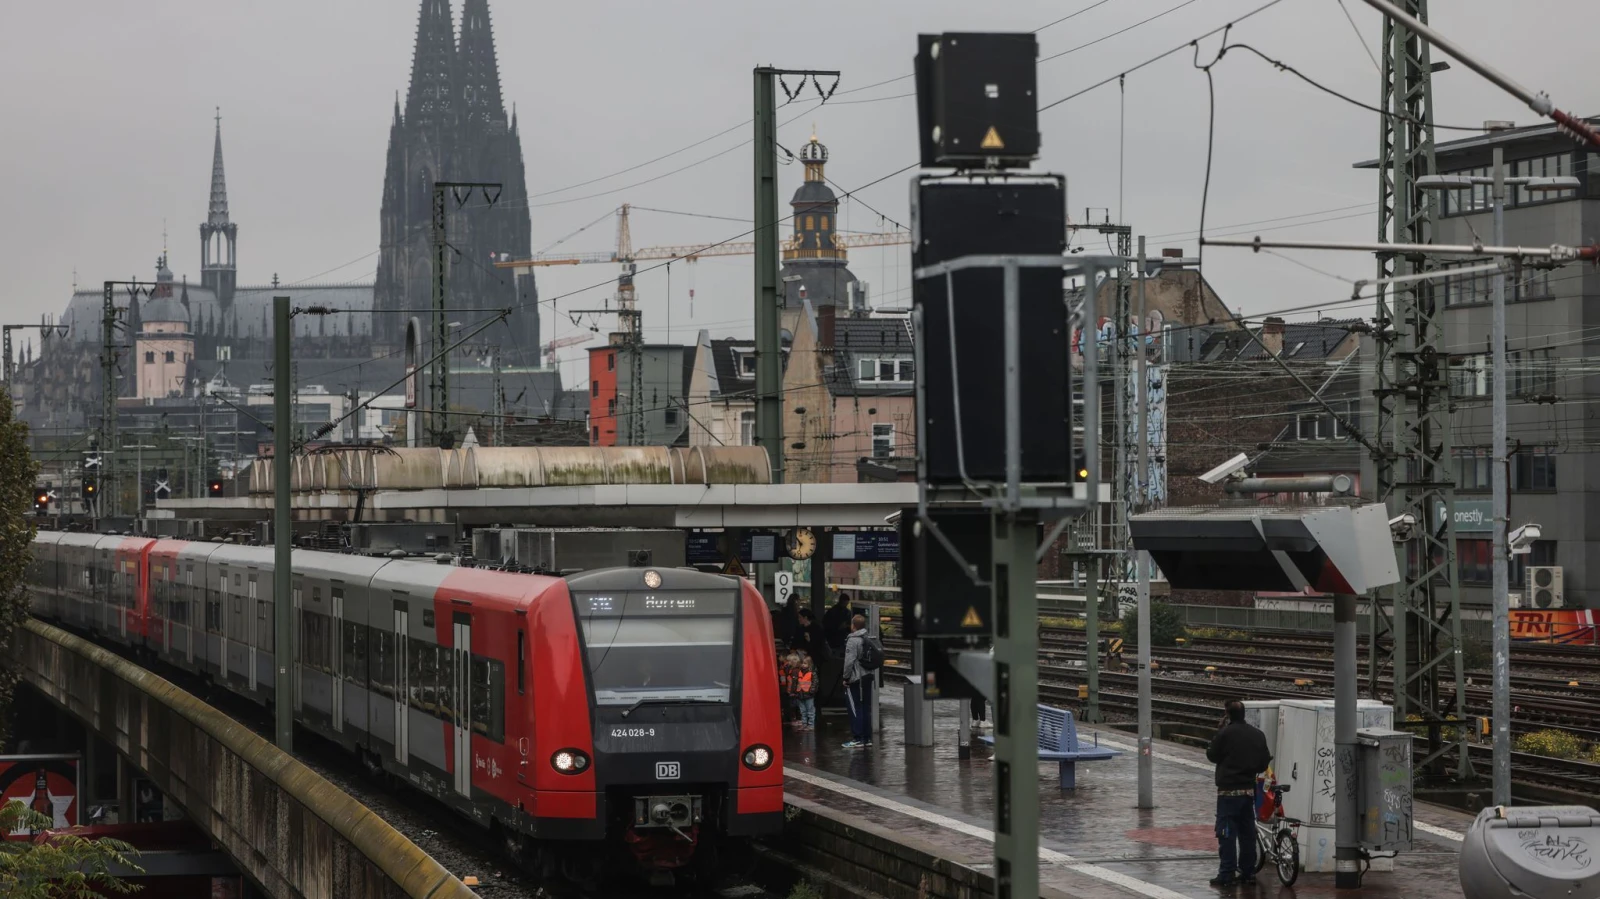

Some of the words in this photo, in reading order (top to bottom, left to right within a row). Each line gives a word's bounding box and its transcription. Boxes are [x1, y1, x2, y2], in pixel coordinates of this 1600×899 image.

[611, 728, 627, 737] 424
[628, 728, 655, 737] 028-9
[658, 765, 678, 777] DB
